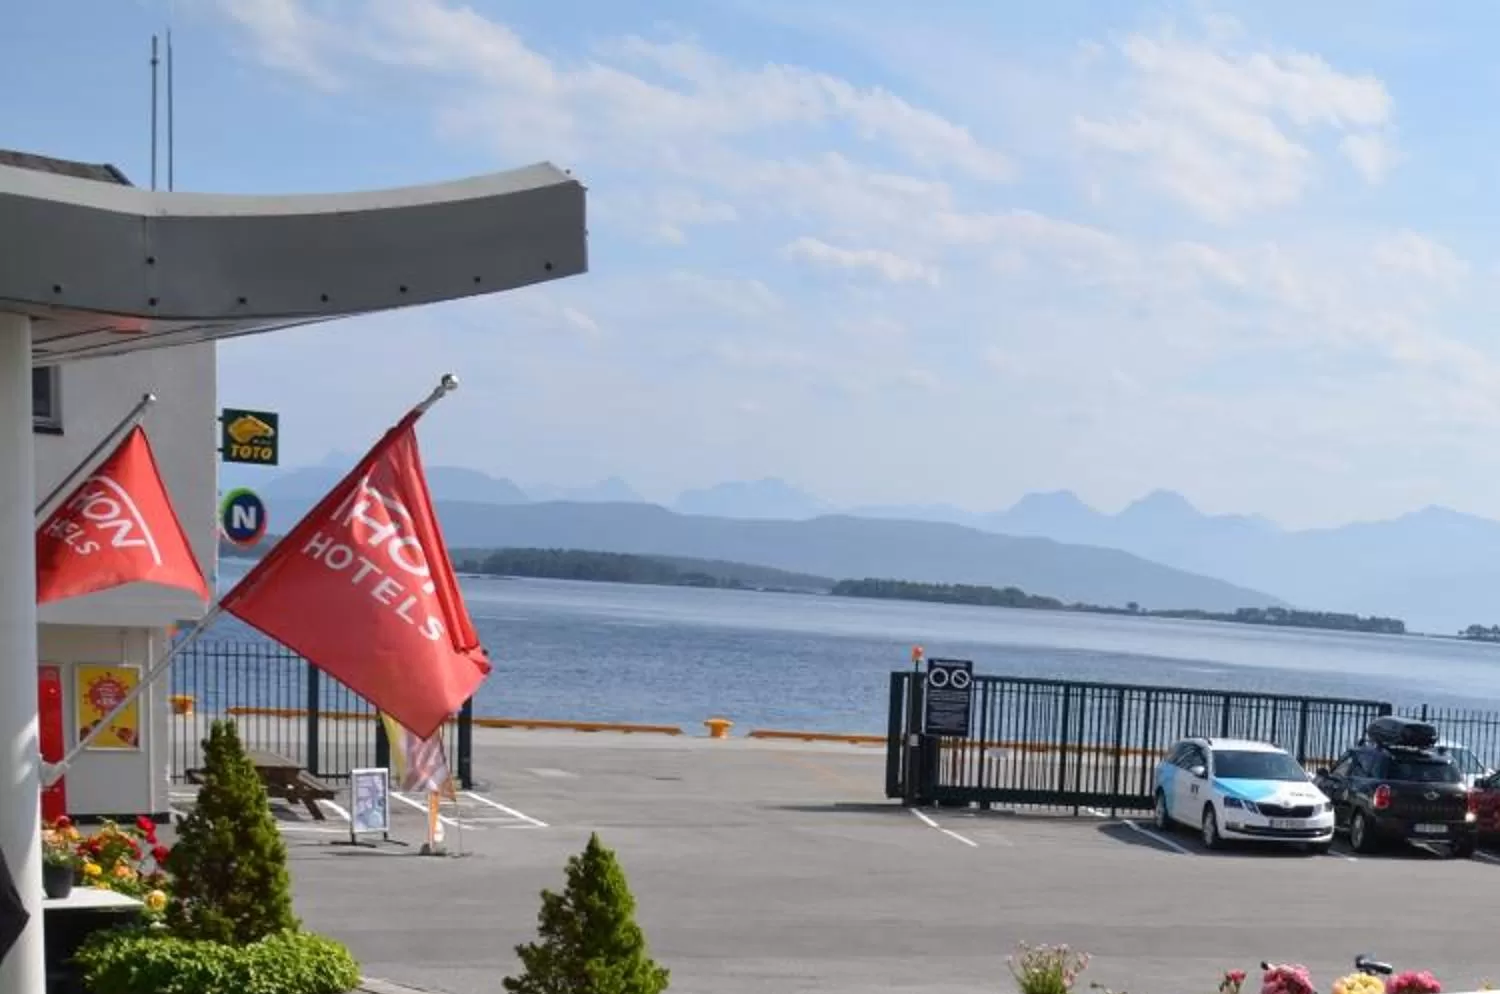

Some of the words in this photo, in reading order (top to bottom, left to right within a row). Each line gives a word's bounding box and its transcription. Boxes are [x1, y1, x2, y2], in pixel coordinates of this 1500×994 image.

[230, 445, 273, 460] TOTO
[232, 504, 257, 530] N
[302, 531, 445, 641] HOTELS
